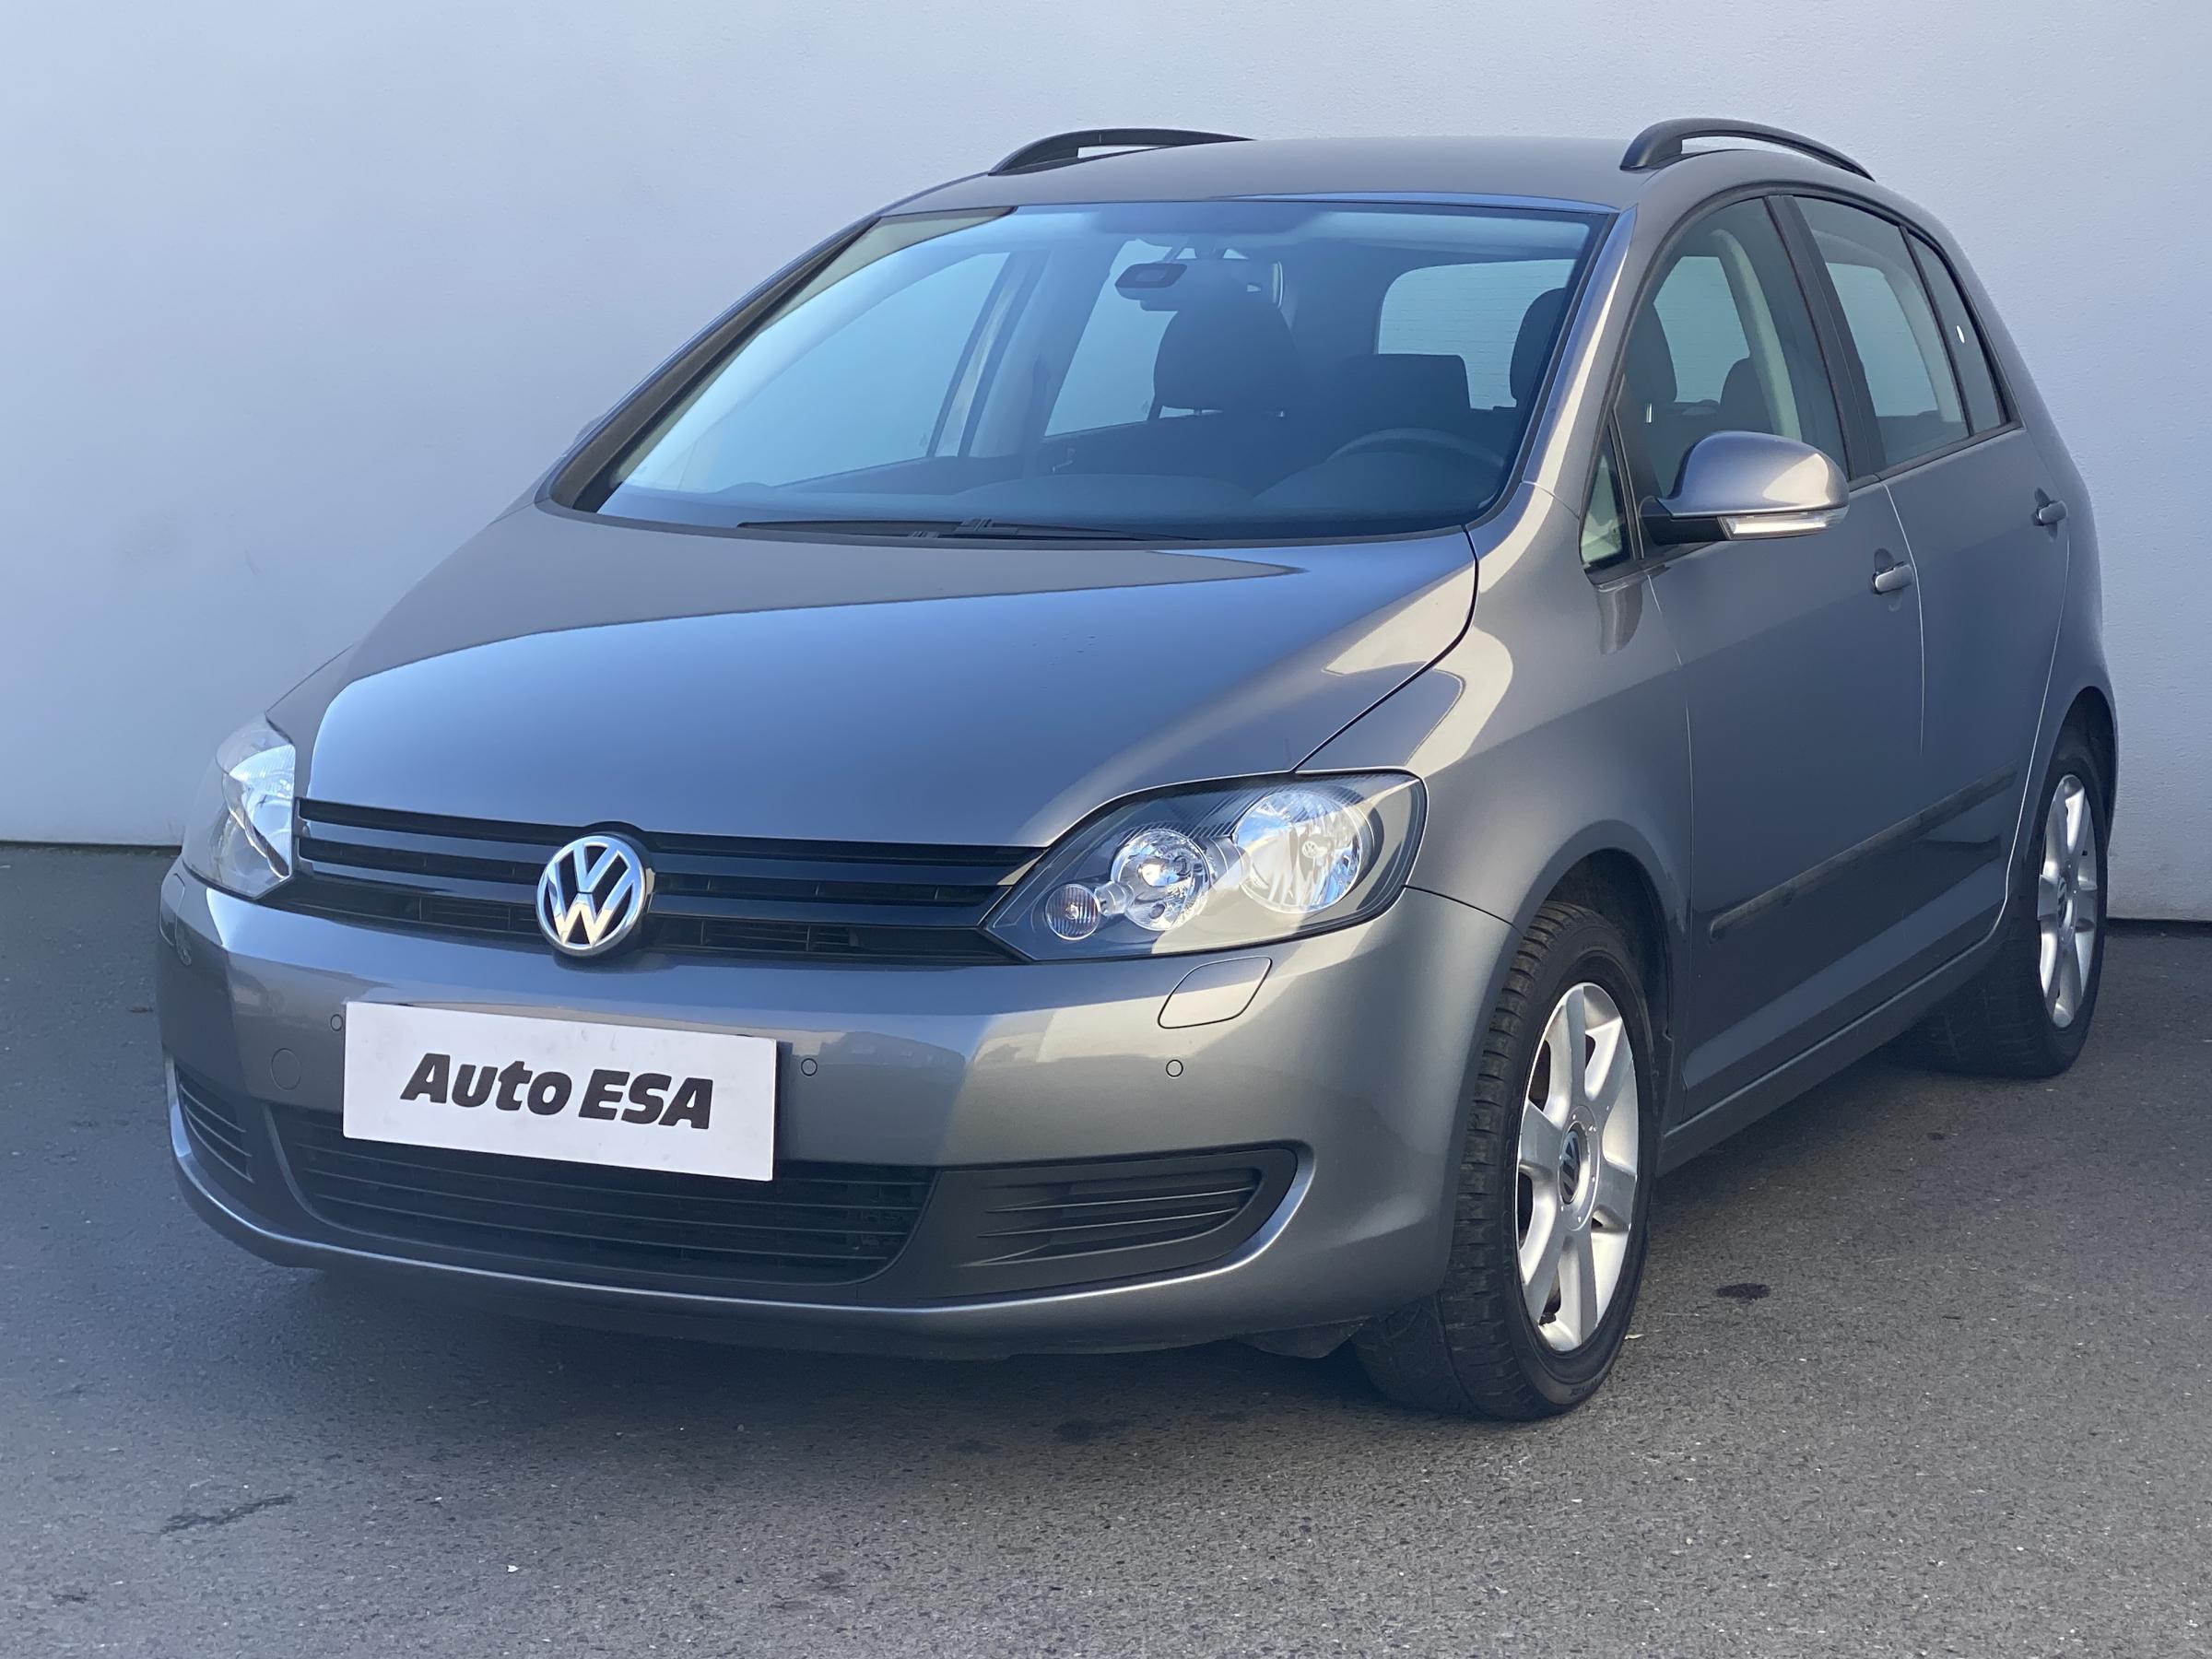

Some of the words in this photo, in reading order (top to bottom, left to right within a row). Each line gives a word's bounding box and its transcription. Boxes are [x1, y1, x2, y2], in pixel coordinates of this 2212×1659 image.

[538, 836, 643, 952] VW
[399, 1053, 572, 1116] Auto
[578, 1068, 713, 1130] ESA
